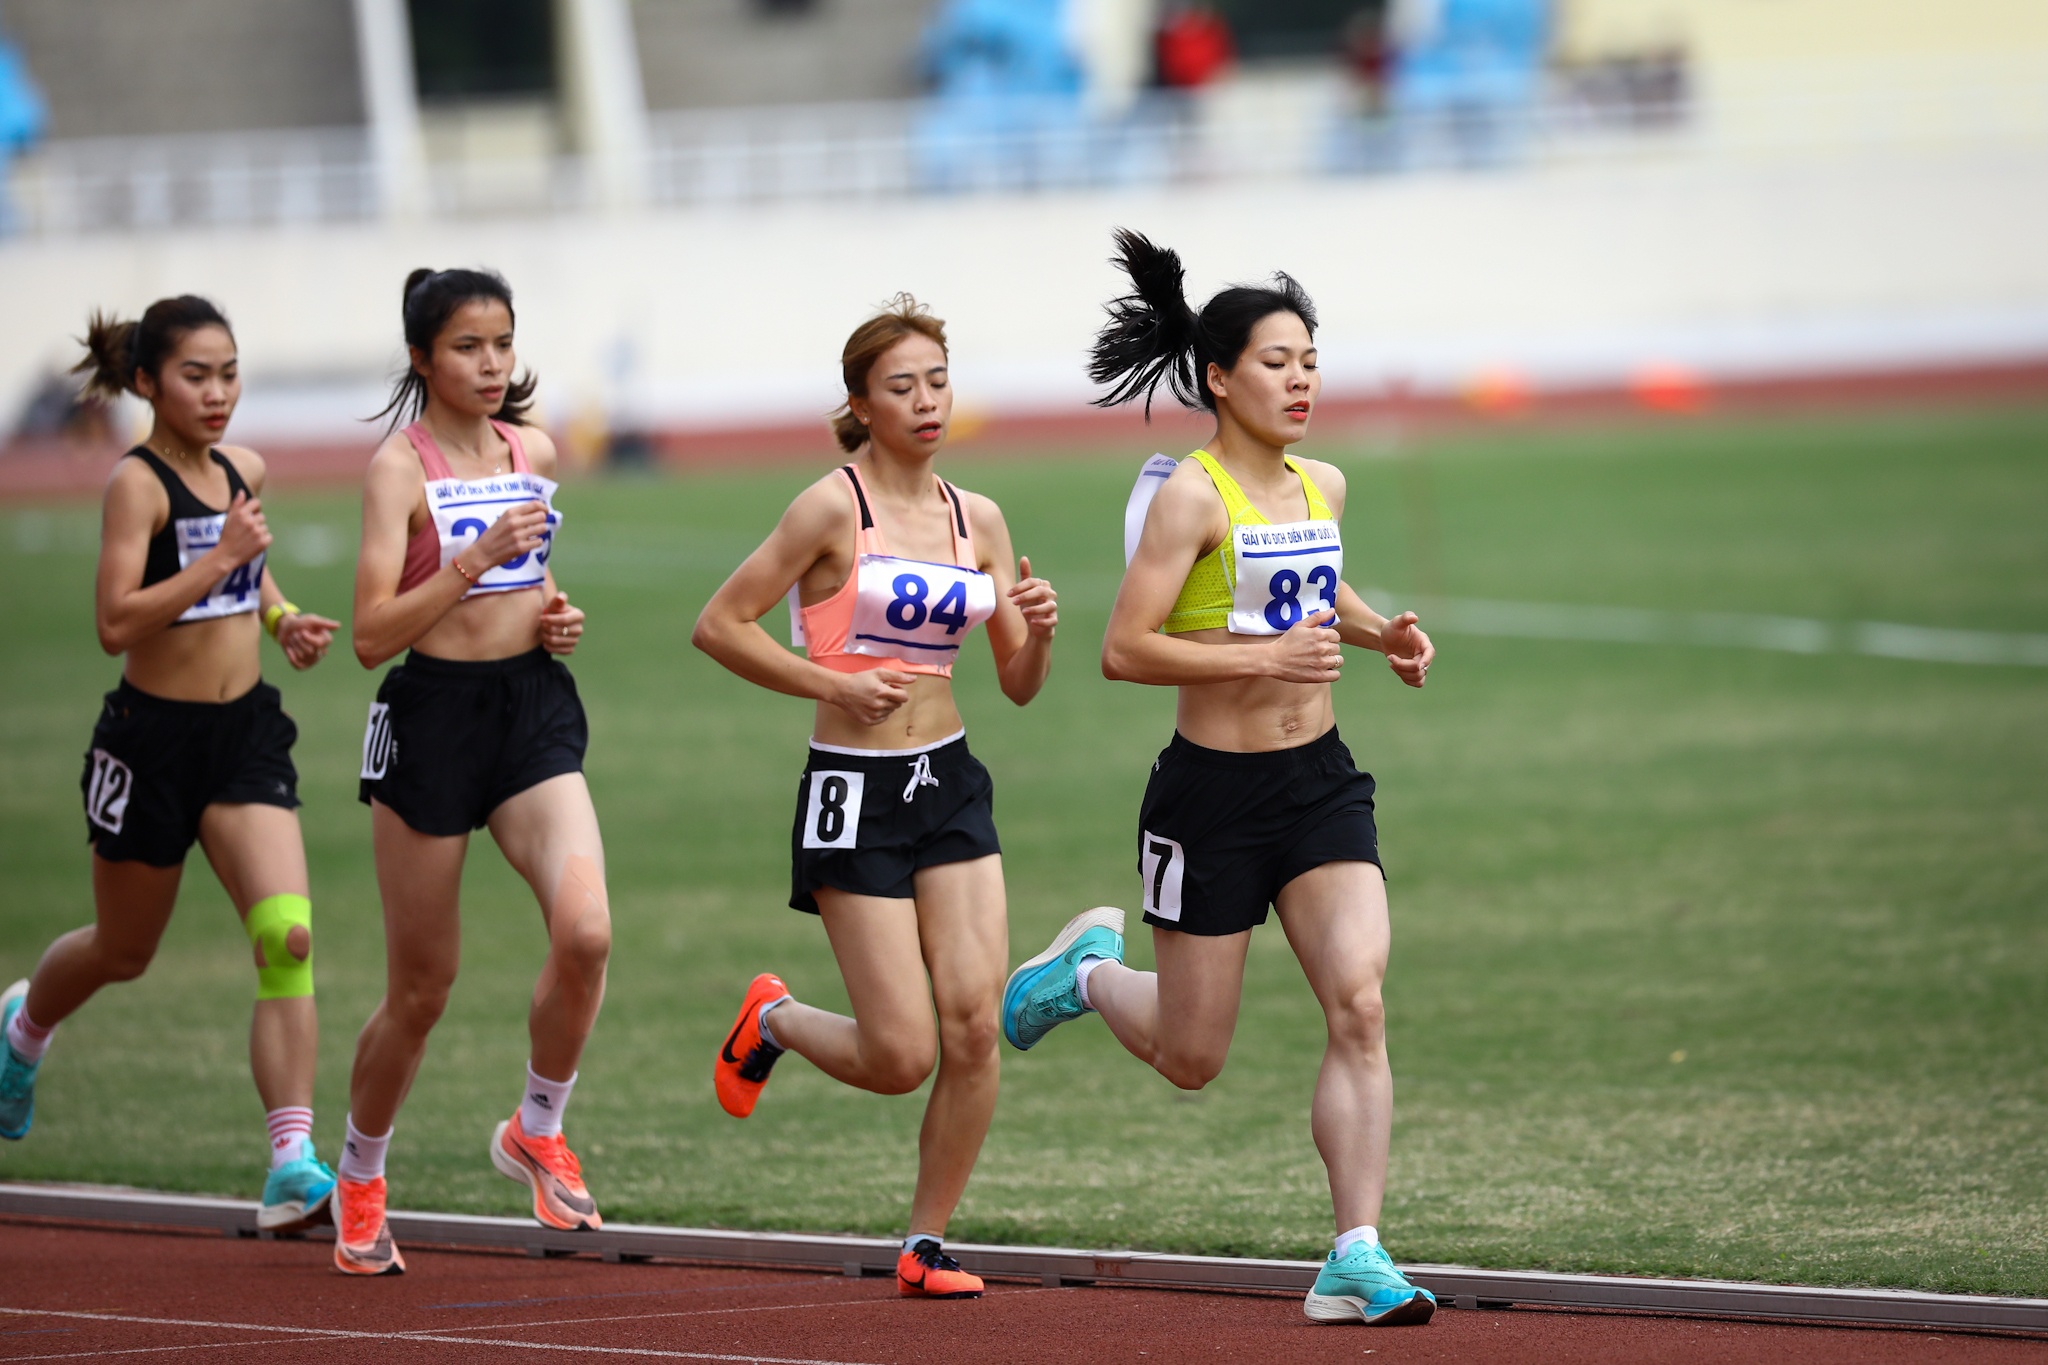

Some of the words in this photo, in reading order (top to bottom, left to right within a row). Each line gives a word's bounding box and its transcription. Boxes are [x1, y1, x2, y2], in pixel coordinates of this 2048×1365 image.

[1242, 530, 1260, 546] GIẢI
[885, 573, 968, 635] 84
[1264, 565, 1337, 631] 83
[366, 708, 390, 774] 10
[94, 758, 127, 826] 12
[816, 775, 849, 843] 8
[1149, 840, 1173, 911] 7
